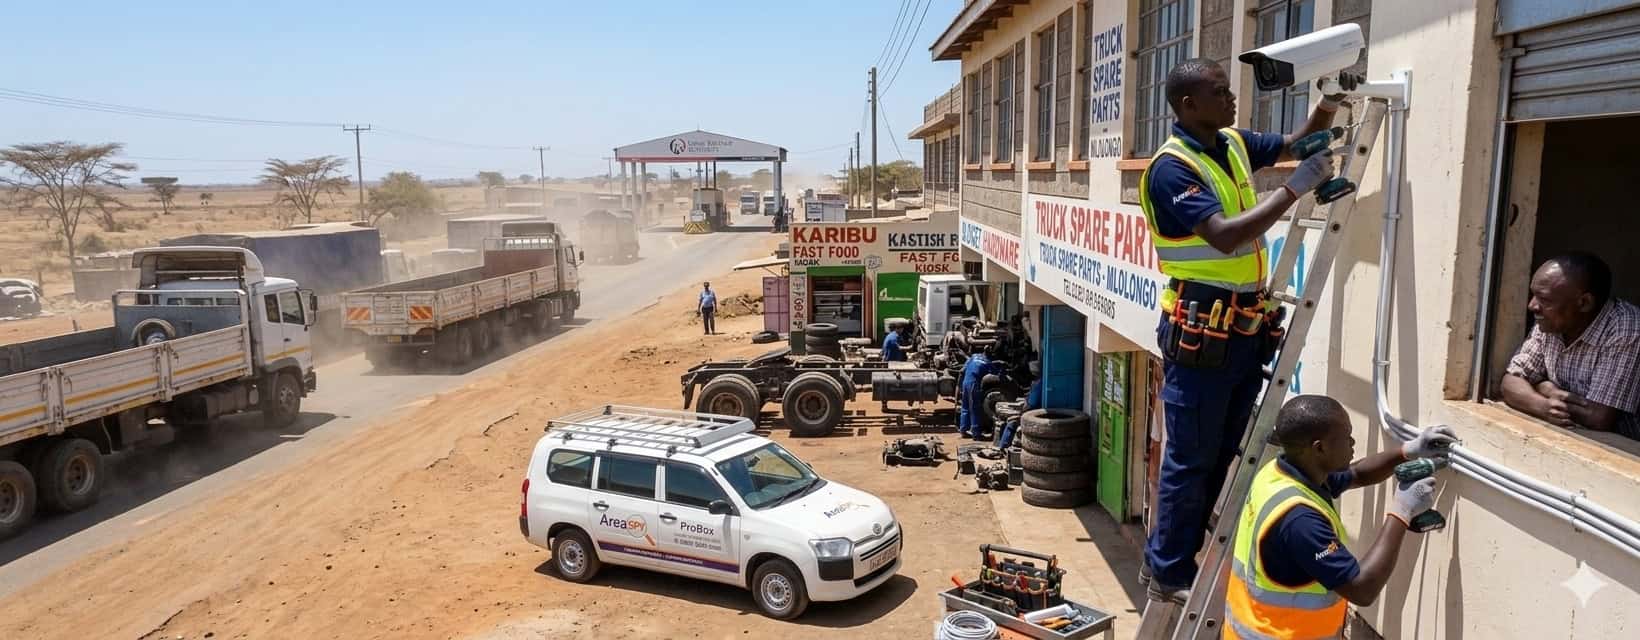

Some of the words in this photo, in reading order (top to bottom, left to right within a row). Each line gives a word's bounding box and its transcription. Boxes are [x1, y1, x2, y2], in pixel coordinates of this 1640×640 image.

[1094, 24, 1123, 61] TRUCK
[1093, 59, 1122, 93] SPARE
[1092, 92, 1120, 123] PARTS
[793, 227, 877, 243] KARIBU
[1036, 201, 1067, 241] TRUCK
[1070, 206, 1110, 256] SPARE
[888, 233, 945, 247] KASTISH
[793, 246, 824, 258] FAST
[829, 246, 859, 258] FOOD
[900, 253, 937, 262] FAST
[915, 264, 949, 272] KIOSK
[1058, 248, 1077, 276] SPARE
[1080, 255, 1101, 287] PARTS
[1106, 265, 1157, 311] MLOLONGO
[680, 522, 714, 536] ProBox
